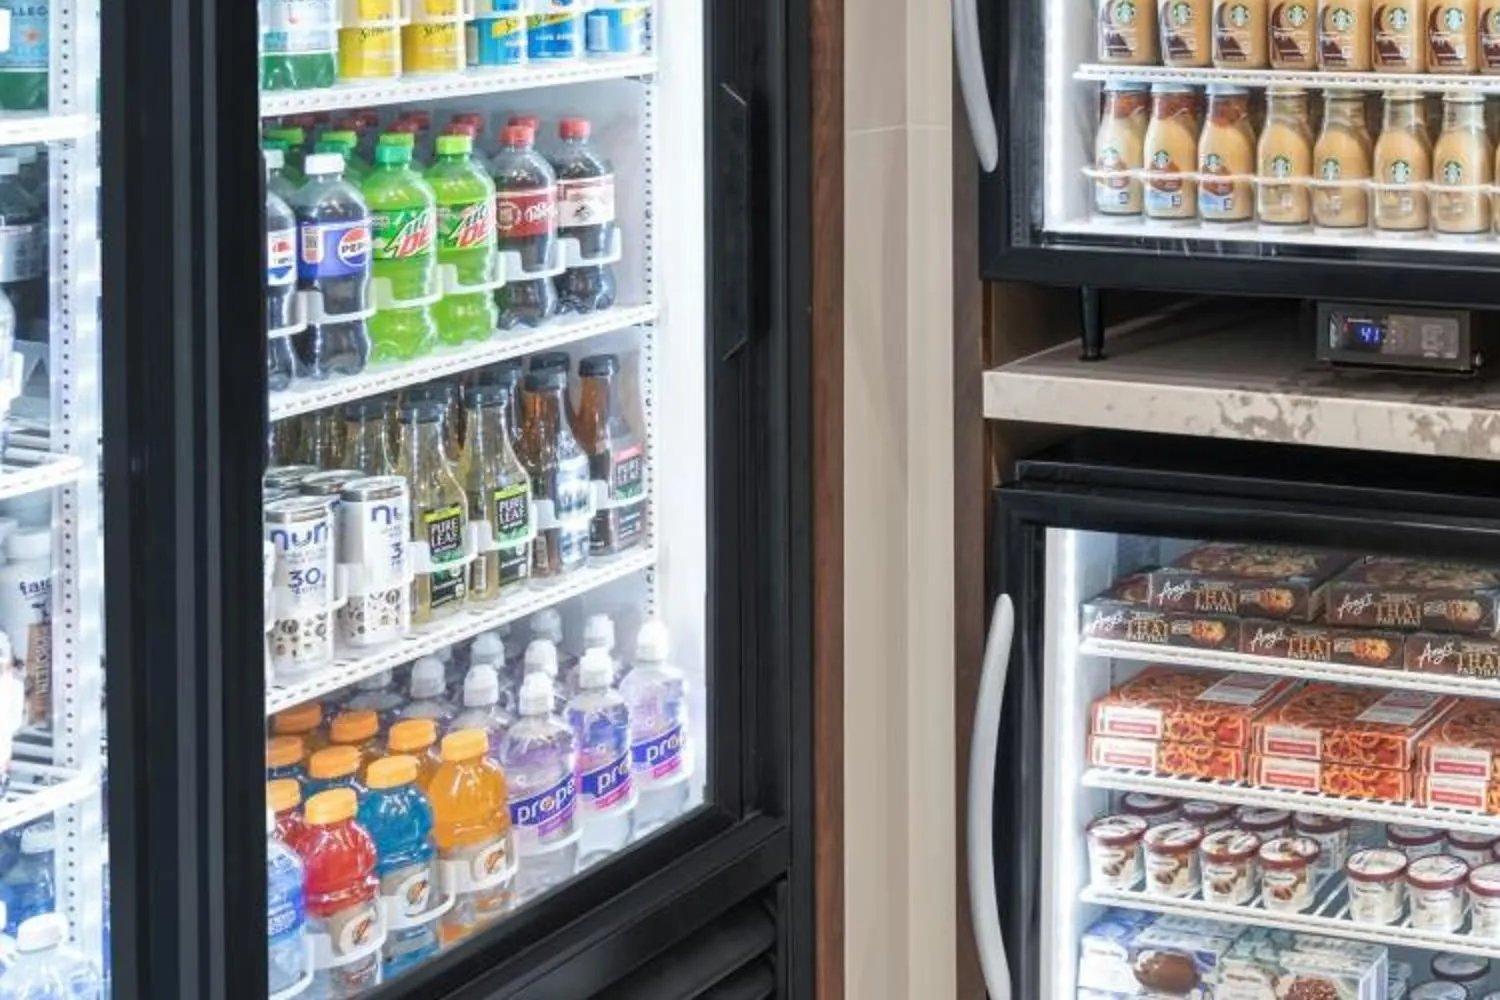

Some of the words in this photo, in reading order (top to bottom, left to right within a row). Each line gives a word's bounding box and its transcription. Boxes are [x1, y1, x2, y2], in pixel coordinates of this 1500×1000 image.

[431, 519, 459, 535] PURE
[431, 529, 460, 549] LEAF
[1194, 589, 1238, 608] THAI
[1337, 593, 1373, 619] Amy's
[1375, 601, 1421, 619] THAI
[1127, 618, 1169, 637] THAI
[1251, 626, 1286, 653] Amy's
[1288, 636, 1332, 655] THAI
[1420, 641, 1455, 667] Amy's
[1456, 650, 1500, 670] THAI
[517, 779, 575, 825] prope
